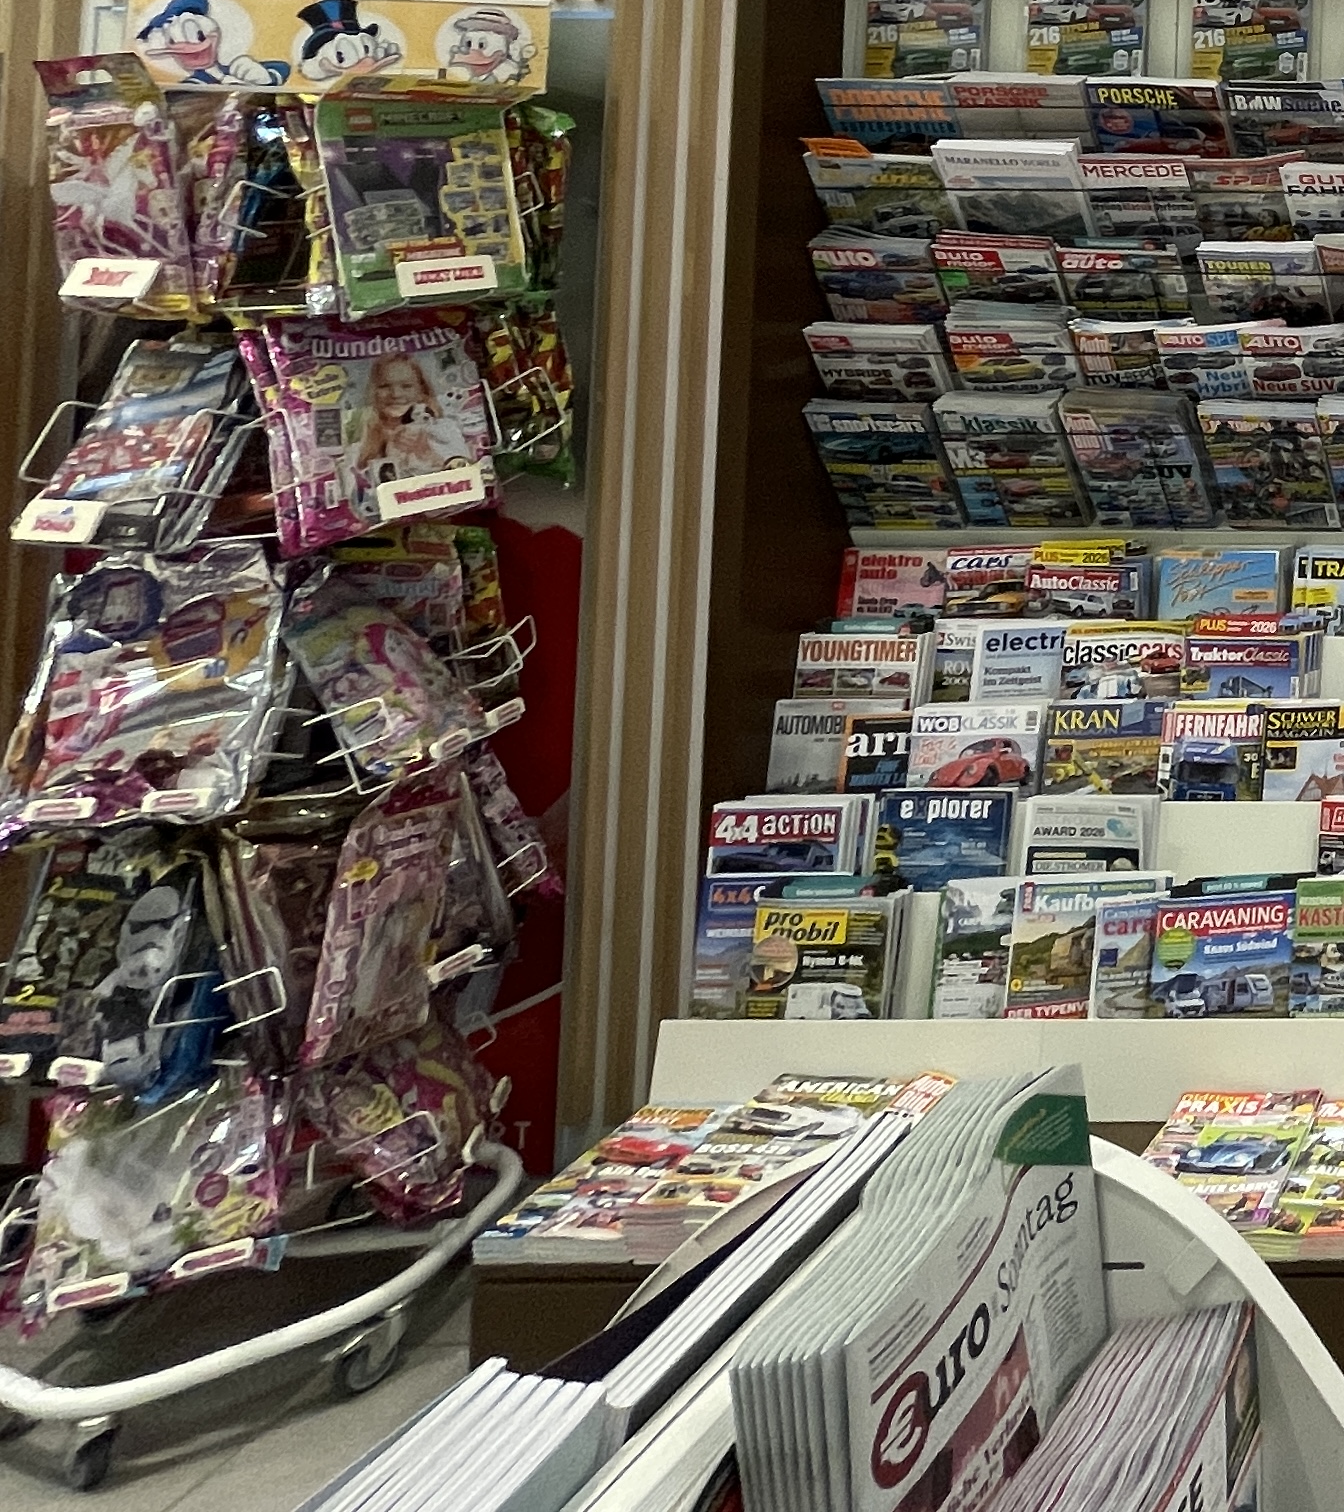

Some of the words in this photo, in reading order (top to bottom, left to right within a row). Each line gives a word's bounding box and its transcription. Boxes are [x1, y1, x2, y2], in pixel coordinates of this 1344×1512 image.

[1098, 88, 1177, 107] PORSCHE
[1030, 573, 1120, 591] AutoClassic
[1251, 621, 1276, 633] 2026
[801, 640, 916, 661] YOUNGTIMER
[1191, 646, 1289, 663] TraktorClassic
[919, 715, 961, 734] WOB
[1056, 708, 1119, 729] KRAN
[765, 911, 802, 928] pro
[1162, 908, 1285, 929] CARAVANING
[771, 921, 839, 943] mobil
[1176, 1100, 1260, 1116] PRAXIS
